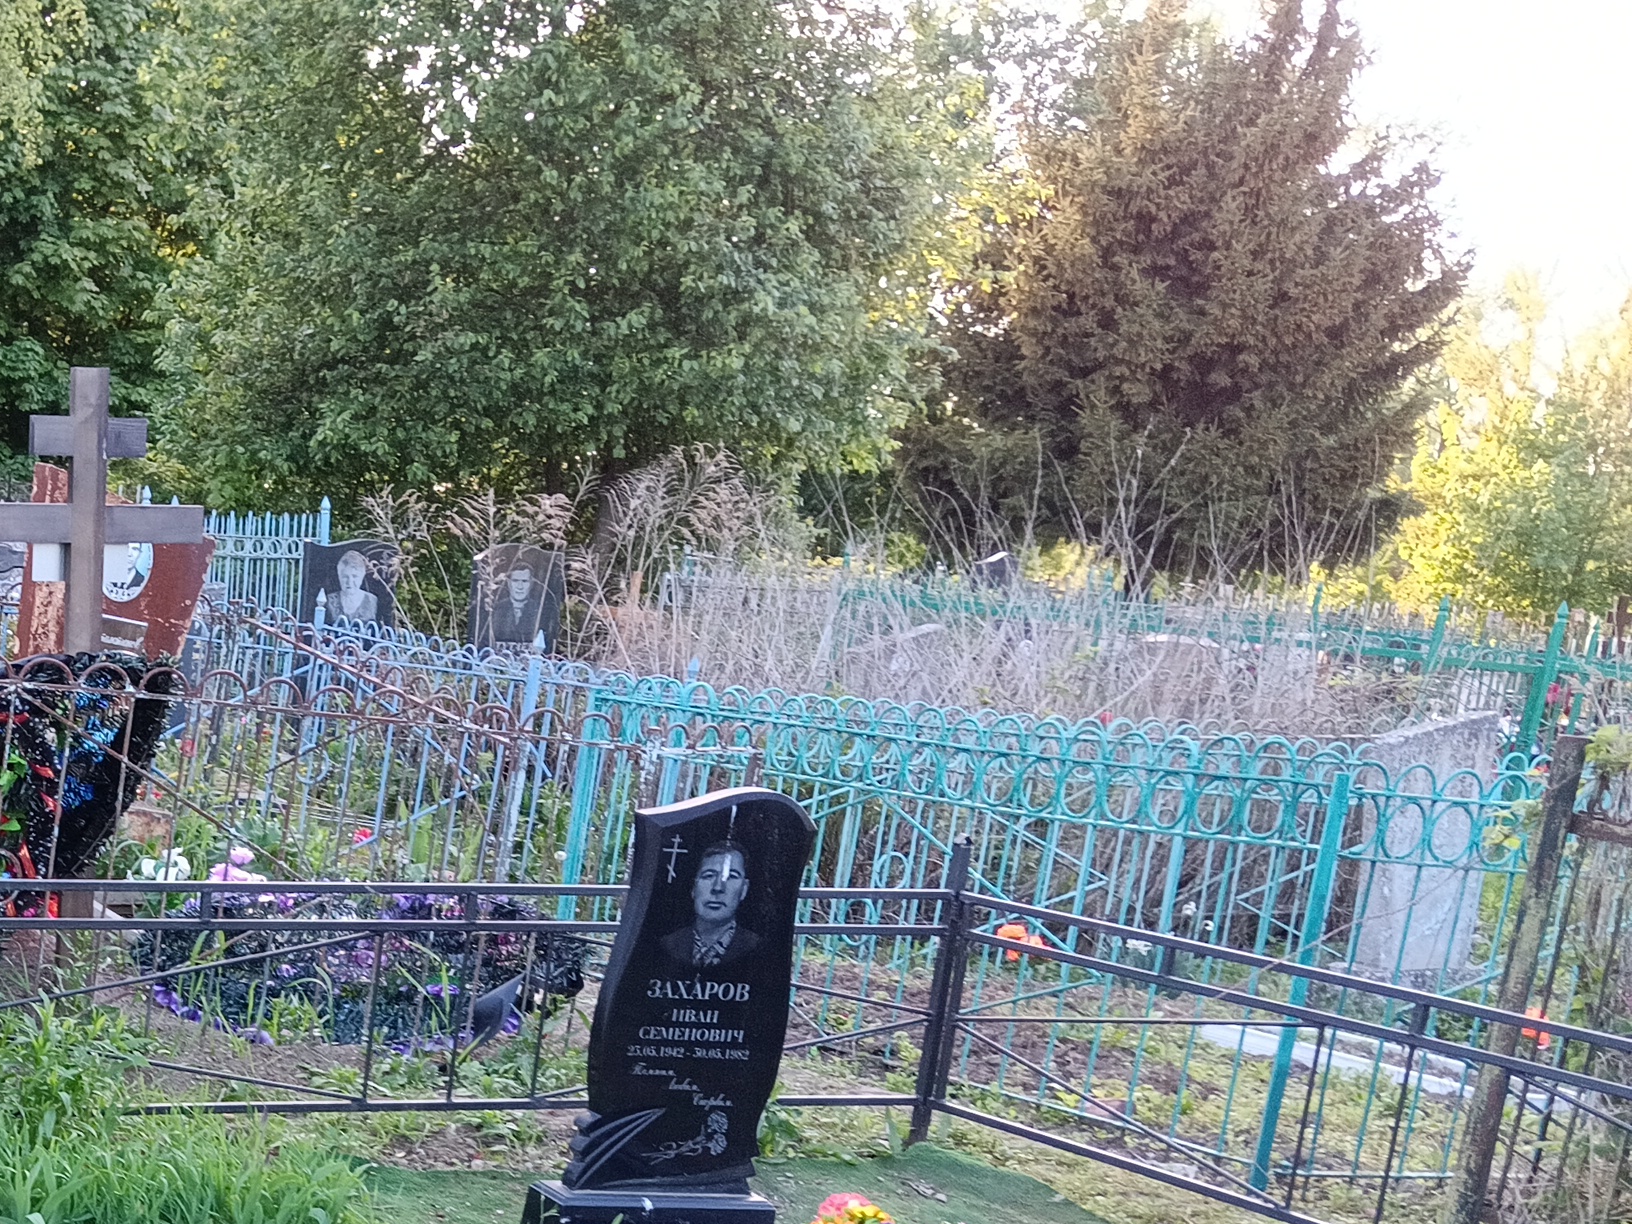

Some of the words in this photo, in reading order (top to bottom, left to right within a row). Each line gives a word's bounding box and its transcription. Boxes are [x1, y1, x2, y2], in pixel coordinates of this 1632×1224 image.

[646, 978, 751, 1002] ЗАХАРОВ
[671, 1007, 720, 1024] ИВАН
[638, 1025, 745, 1043] СЕМЕНОВИЧ
